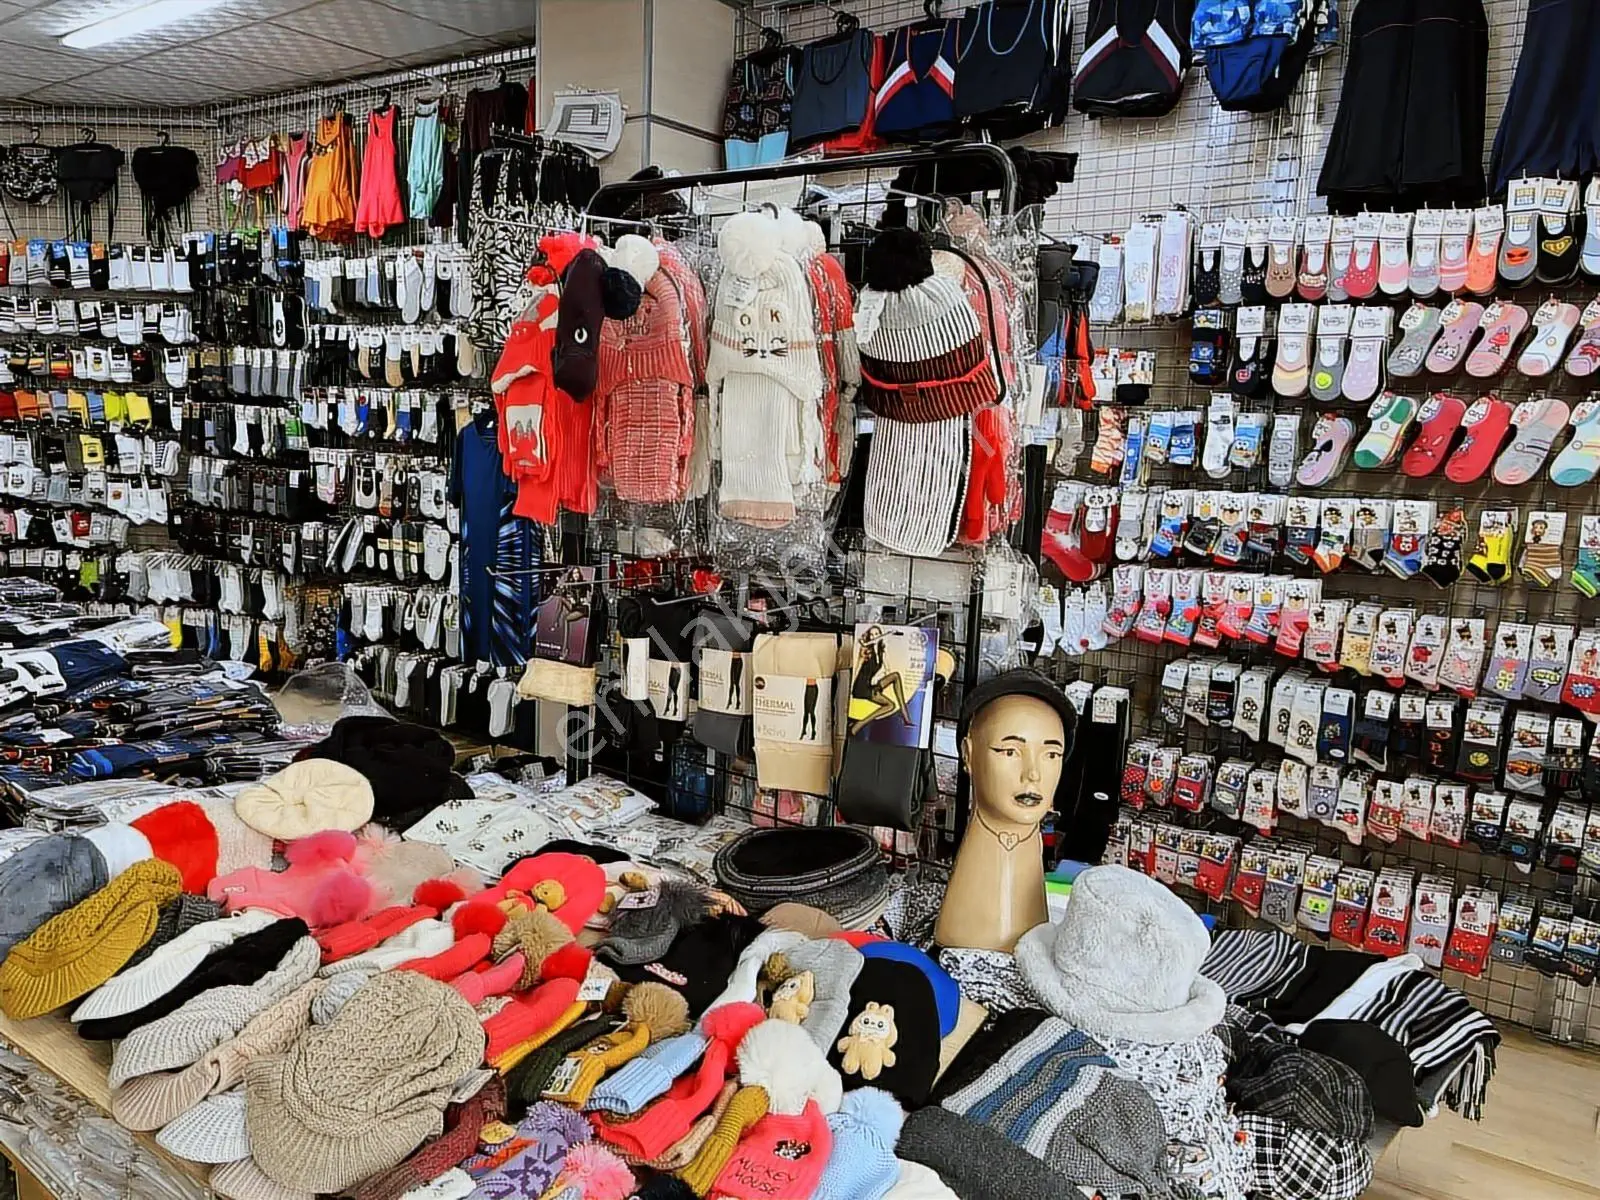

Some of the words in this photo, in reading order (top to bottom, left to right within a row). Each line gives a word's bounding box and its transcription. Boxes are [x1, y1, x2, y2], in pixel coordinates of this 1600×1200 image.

[755, 697, 796, 711] THERMAL
[1378, 907, 1396, 917] arc
[1421, 914, 1439, 923] arc
[1462, 921, 1480, 932] arc
